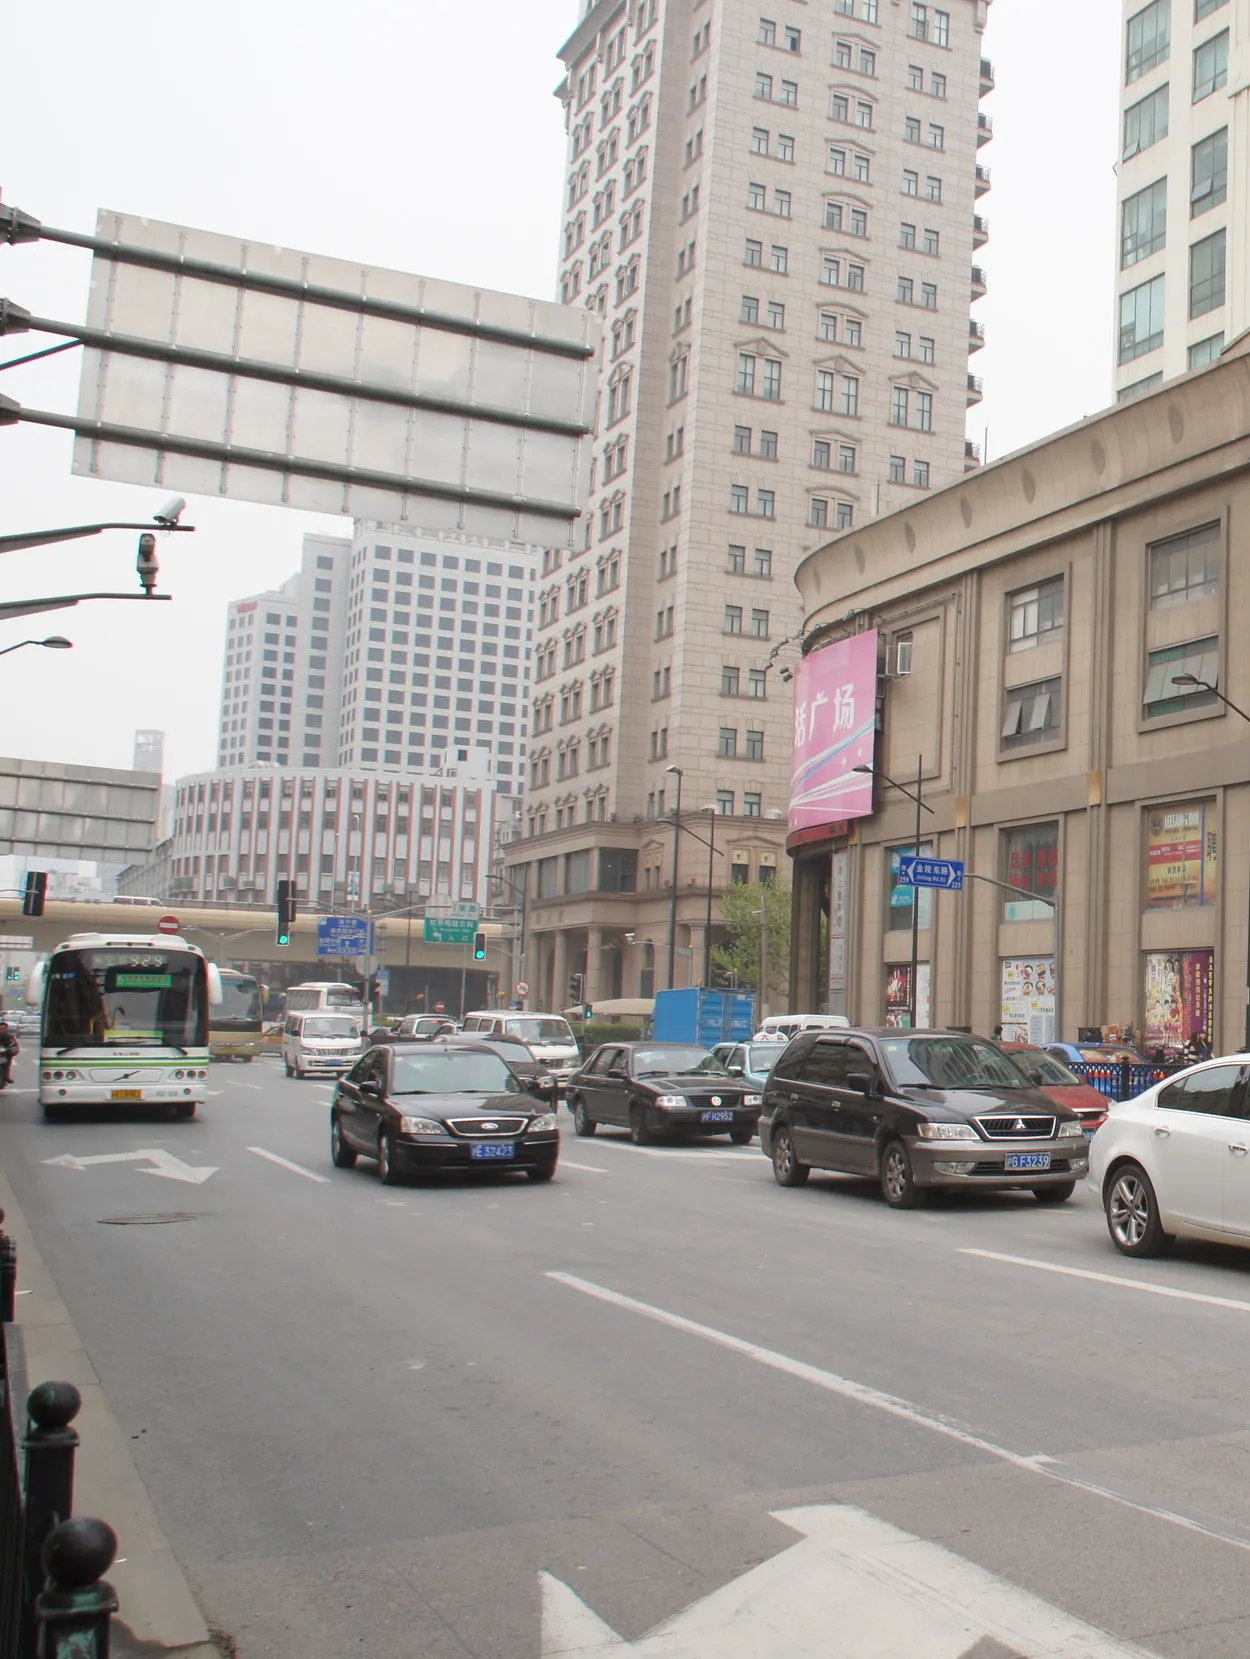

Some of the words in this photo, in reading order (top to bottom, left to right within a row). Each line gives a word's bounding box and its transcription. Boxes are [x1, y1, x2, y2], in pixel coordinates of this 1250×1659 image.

[795, 684, 855, 747] 活广场
[916, 864, 949, 875] 金陵东路
[900, 876, 909, 884] 259
[131, 954, 163, 967] 929
